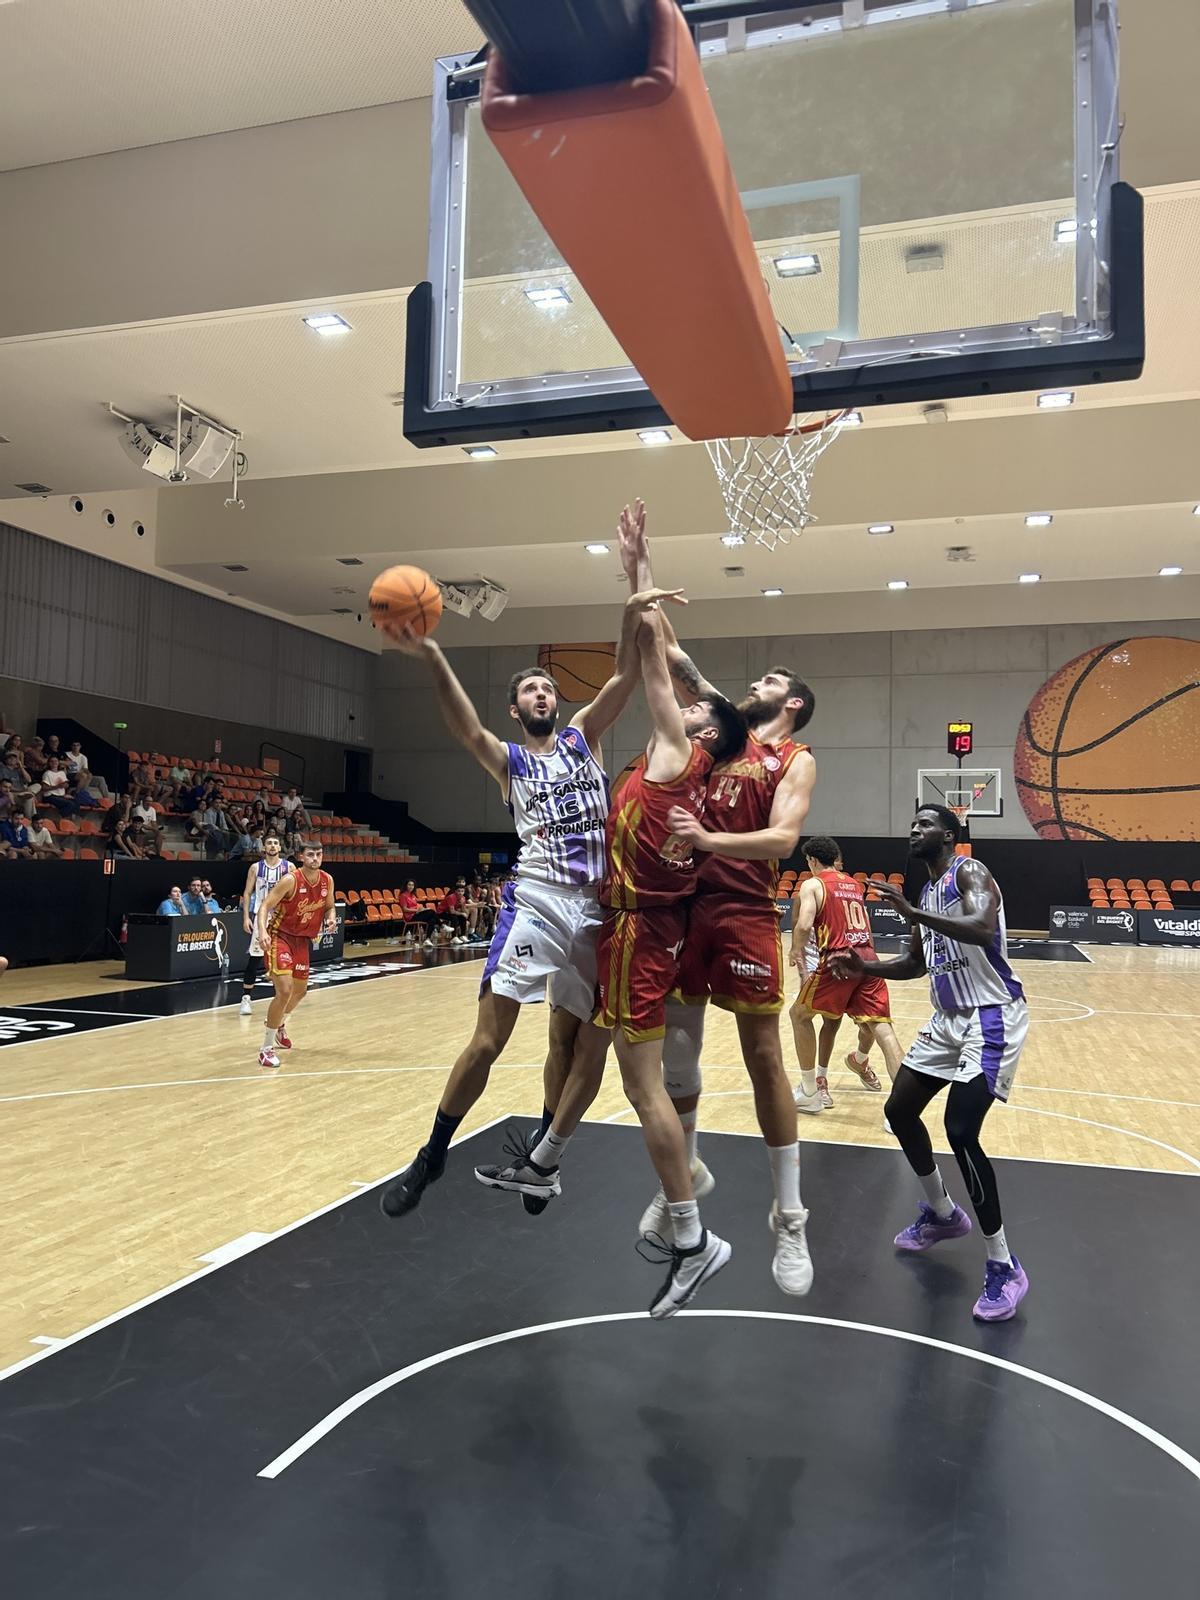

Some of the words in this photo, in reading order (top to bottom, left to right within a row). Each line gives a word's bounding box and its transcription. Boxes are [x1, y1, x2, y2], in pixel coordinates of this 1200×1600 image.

[955, 735, 971, 752] 19
[711, 776, 743, 808] 14
[558, 800, 580, 817] 16
[842, 900, 867, 930] 10
[178, 931, 215, 943] L'ALQUERIA
[322, 934, 334, 945] club
[176, 943, 189, 953] DEL
[189, 940, 214, 951] BASKET
